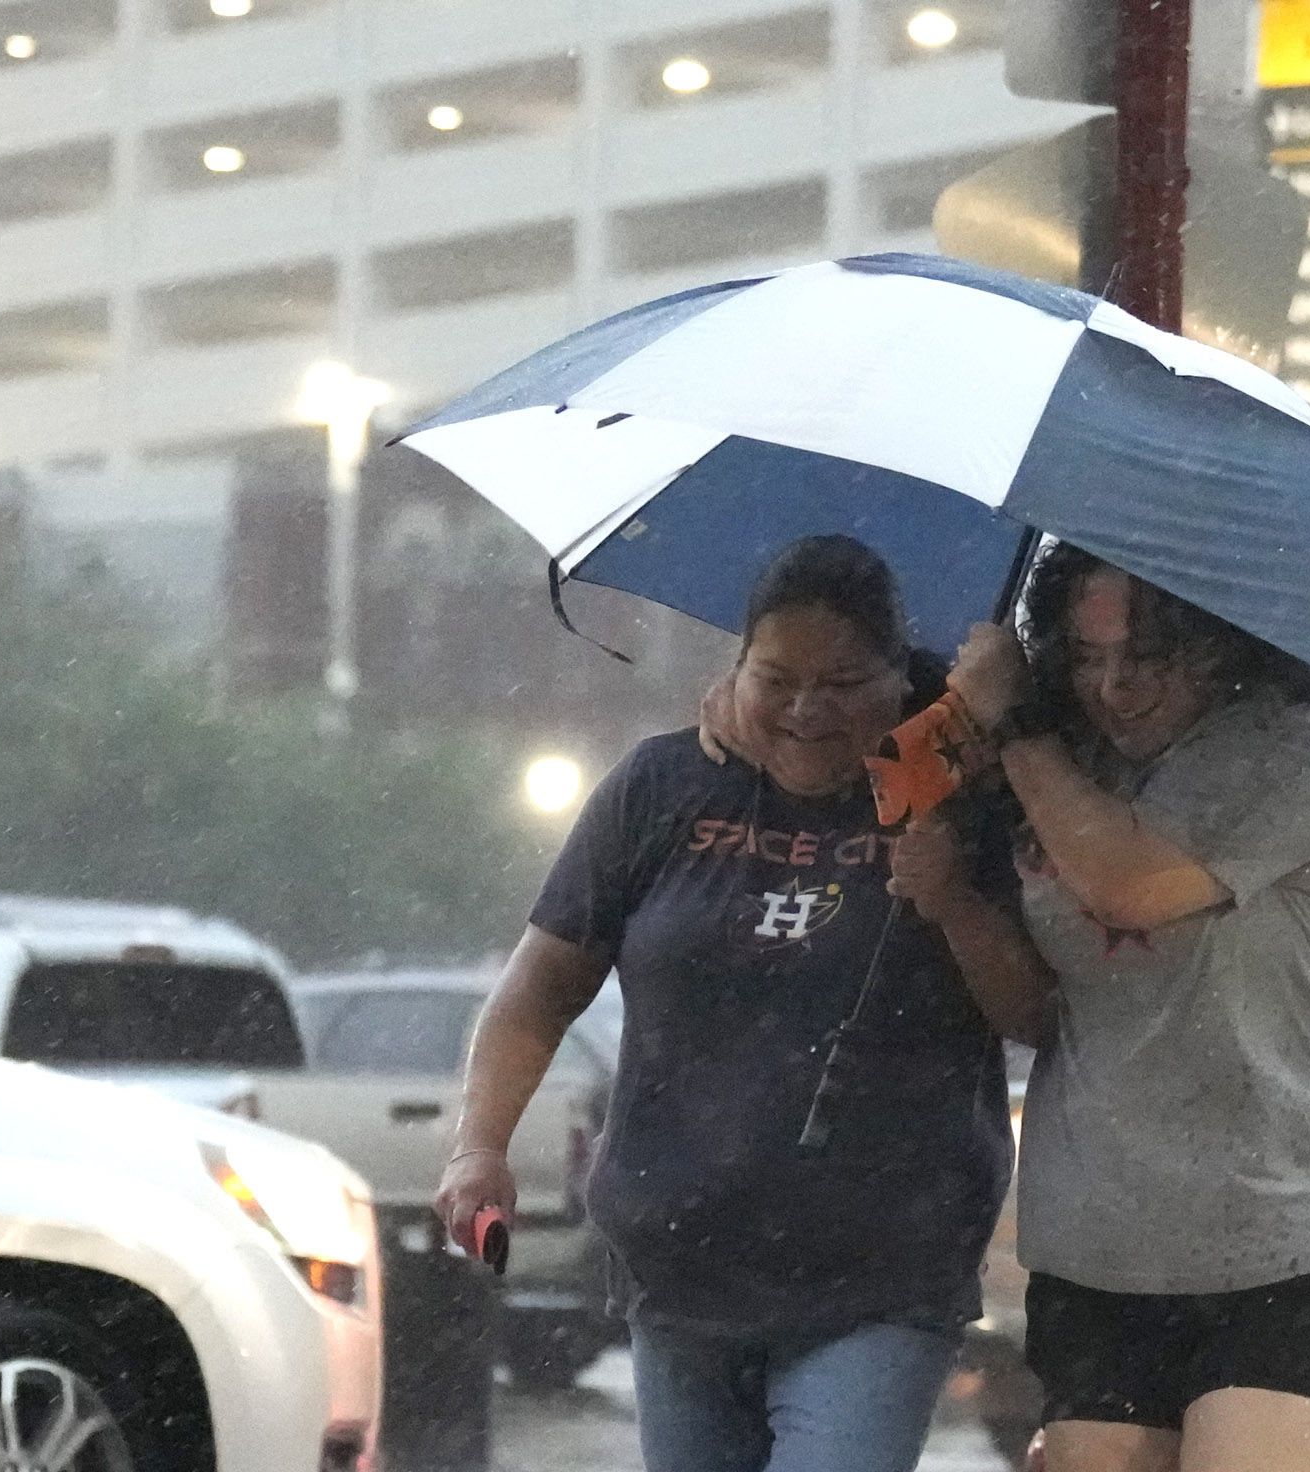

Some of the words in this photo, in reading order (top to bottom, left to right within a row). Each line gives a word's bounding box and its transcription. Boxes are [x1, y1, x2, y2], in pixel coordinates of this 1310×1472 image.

[688, 818, 821, 866] SPACE
[834, 832, 896, 866] CIT
[754, 890, 818, 939] H
